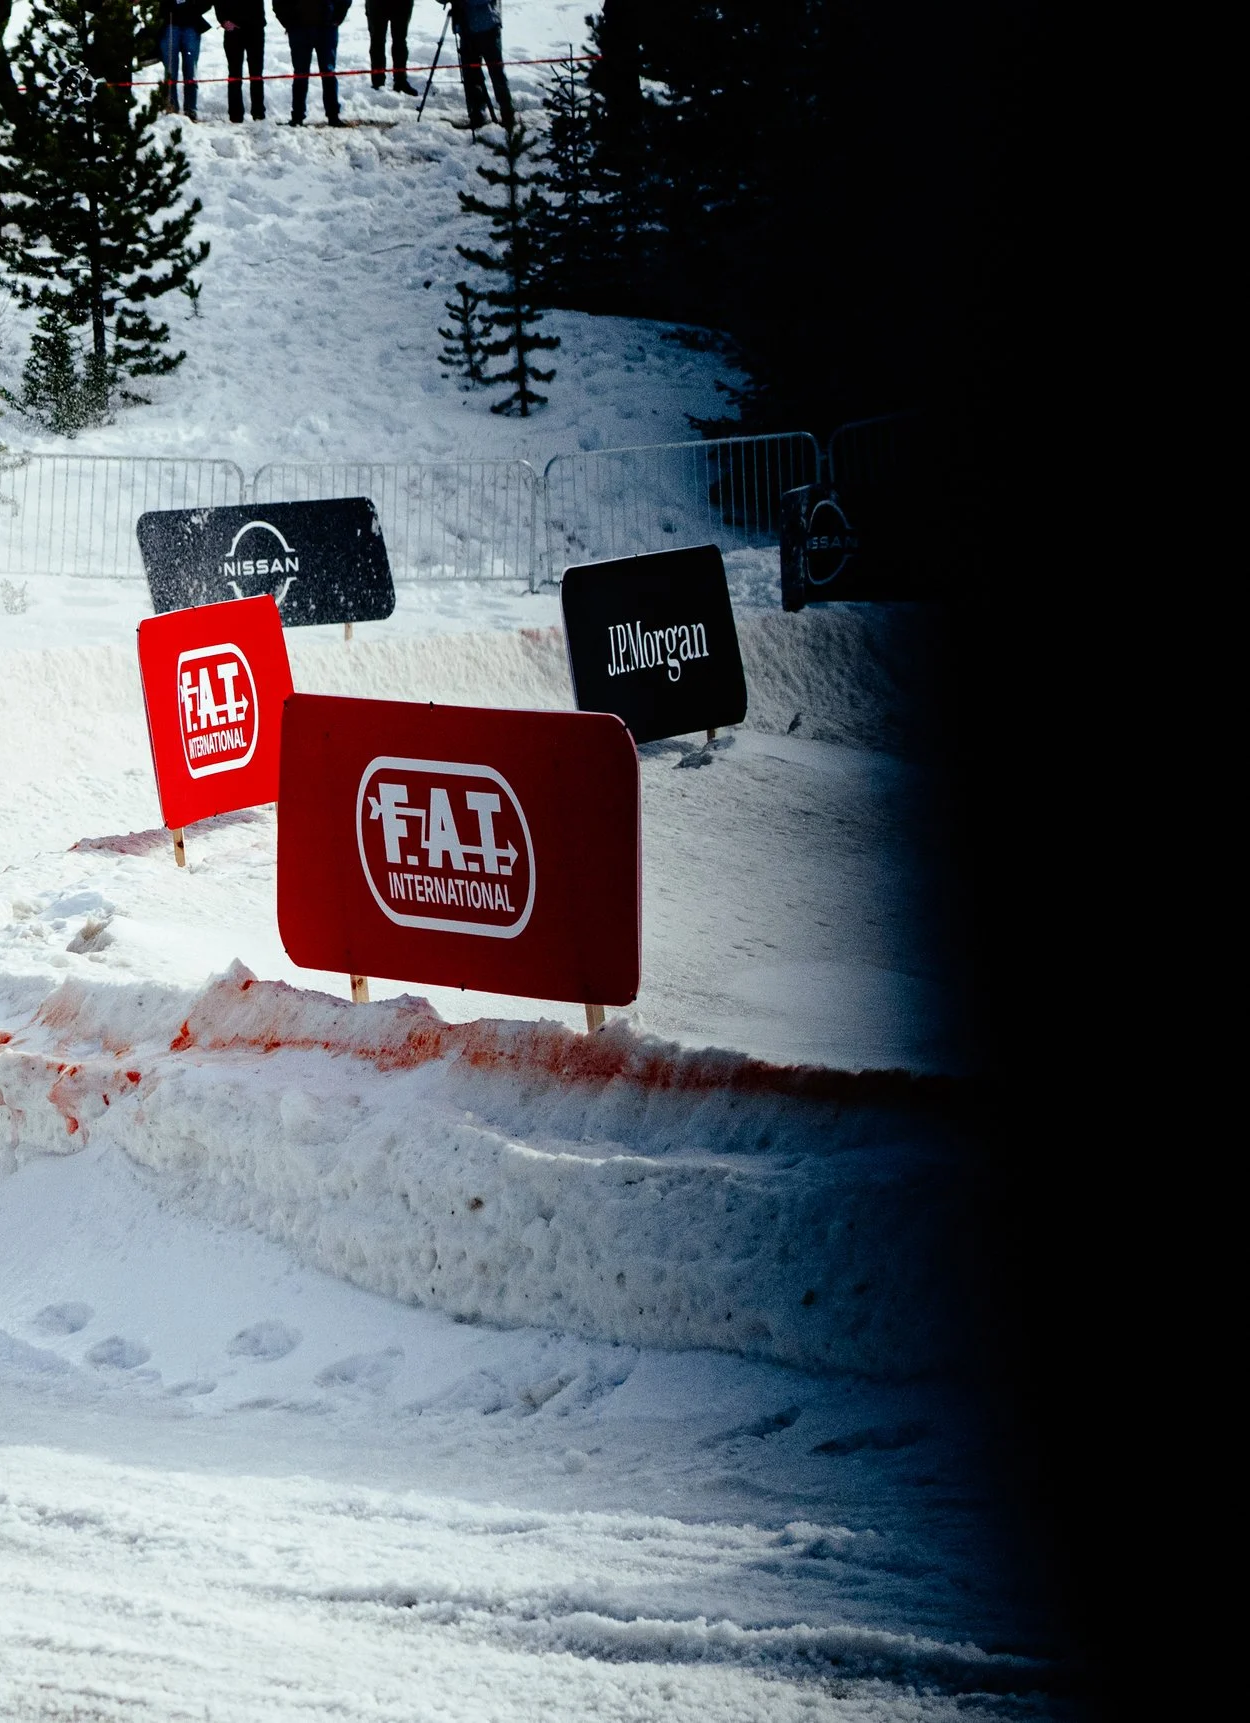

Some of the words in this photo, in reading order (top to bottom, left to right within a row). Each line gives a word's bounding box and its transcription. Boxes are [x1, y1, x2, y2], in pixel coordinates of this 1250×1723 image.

[805, 535, 859, 552] ISSAN
[223, 556, 300, 577] NISSAN
[181, 661, 246, 734] F.A.T.
[188, 726, 248, 760] INTERNATIONAL
[378, 782, 514, 876] F.A.T.
[387, 871, 516, 913] INTERNATIONAL
